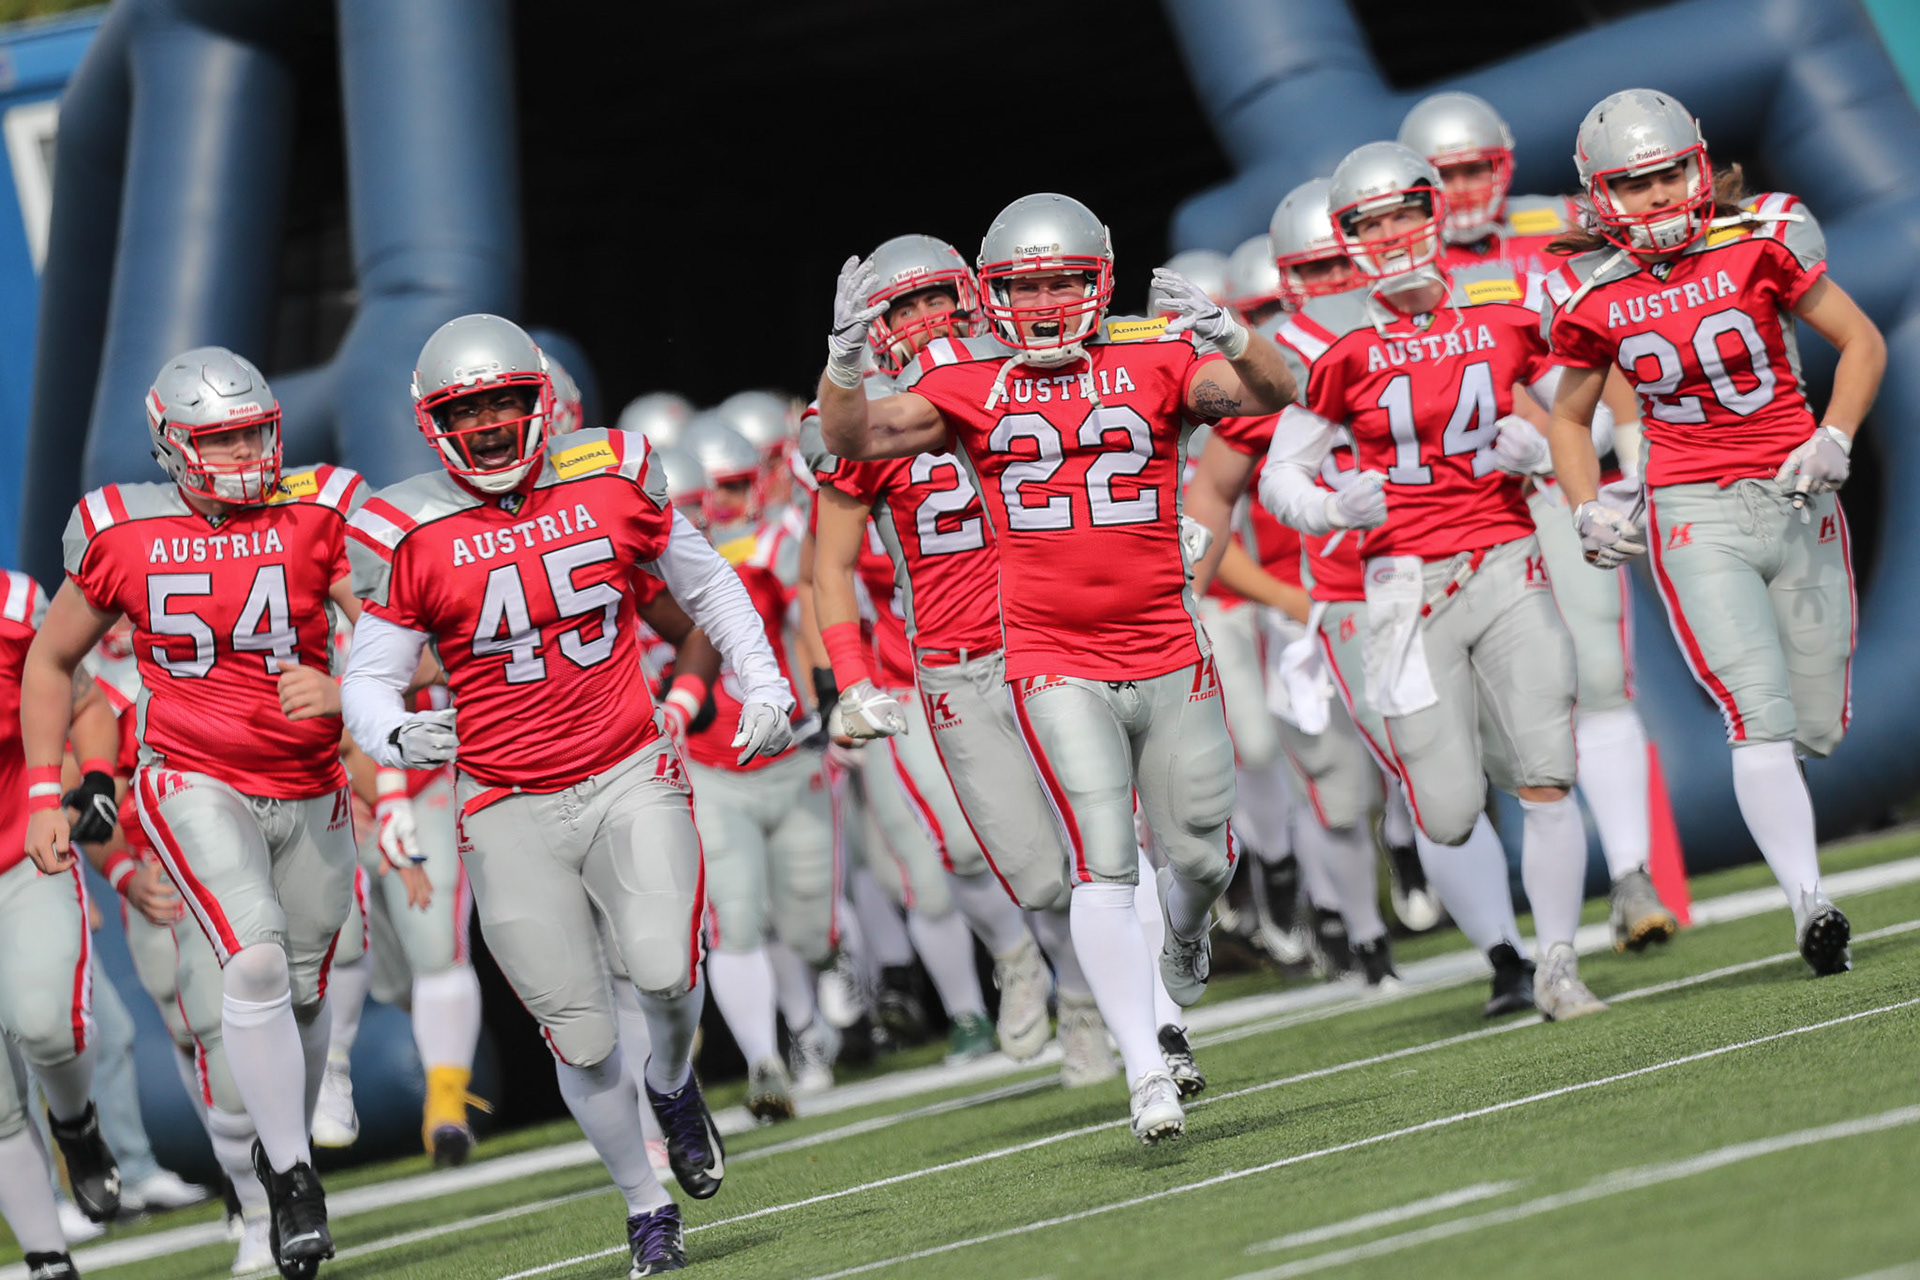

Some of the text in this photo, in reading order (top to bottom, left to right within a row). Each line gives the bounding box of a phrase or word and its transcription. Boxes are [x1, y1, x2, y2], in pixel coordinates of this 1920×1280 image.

[1112, 323, 1166, 335] ADMIRAL
[1607, 270, 1737, 328] AUSTRIA
[1367, 324, 1496, 373] AUSTRIA
[1617, 307, 1775, 425] 20
[229, 405, 259, 417] Riddell
[1377, 361, 1500, 486] 14
[559, 449, 611, 470] ADMIRAL
[989, 404, 1159, 531] 22
[149, 527, 284, 563] AUSTRIA
[452, 503, 598, 567] AUSTRIA
[147, 563, 299, 679] 54
[471, 536, 623, 685] 45
